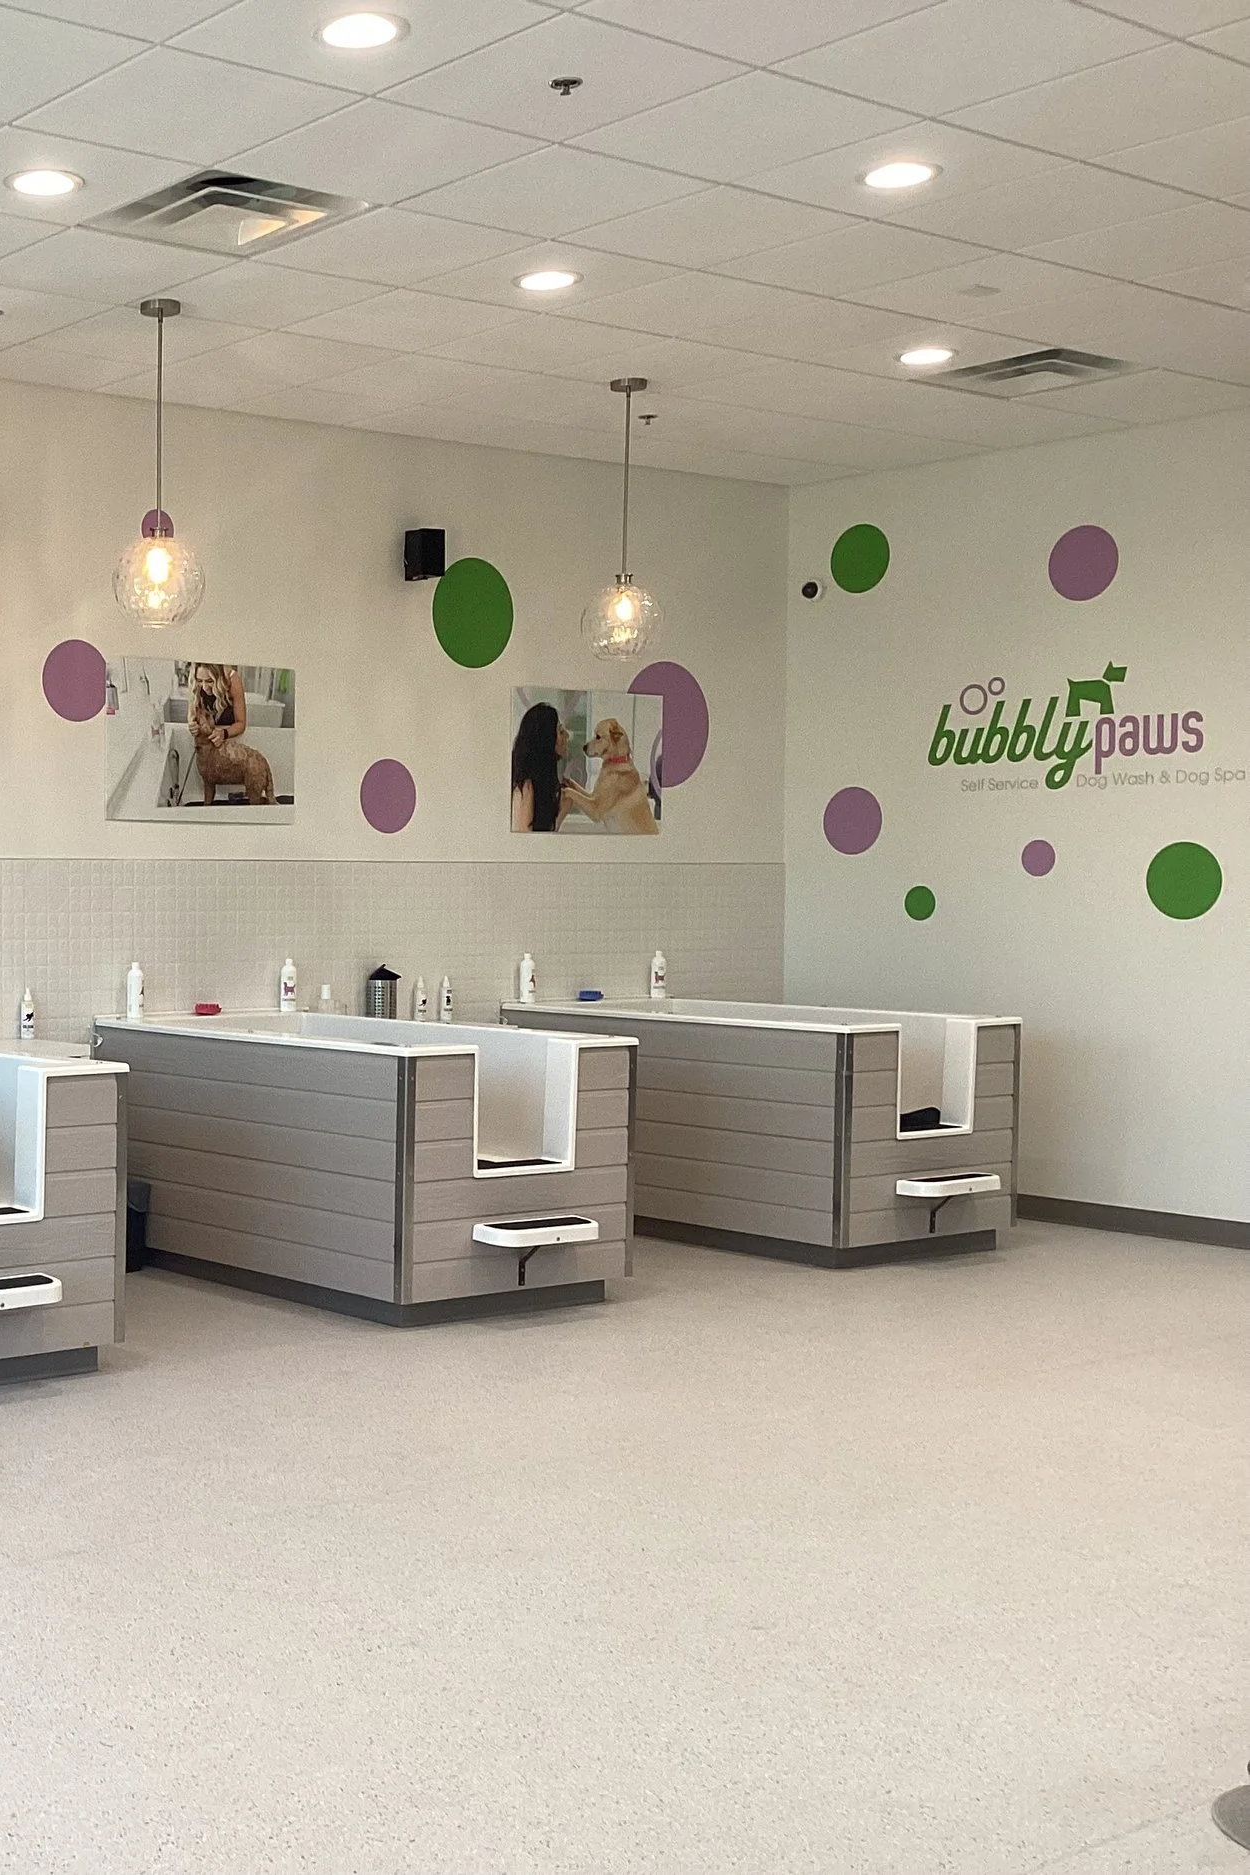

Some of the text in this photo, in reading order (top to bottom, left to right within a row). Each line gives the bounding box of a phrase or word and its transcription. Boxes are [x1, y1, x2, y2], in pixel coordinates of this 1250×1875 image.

[928, 696, 1204, 790] bubbly paws
[960, 767, 1247, 792] Self Service Dog Wash & Dog Spa
